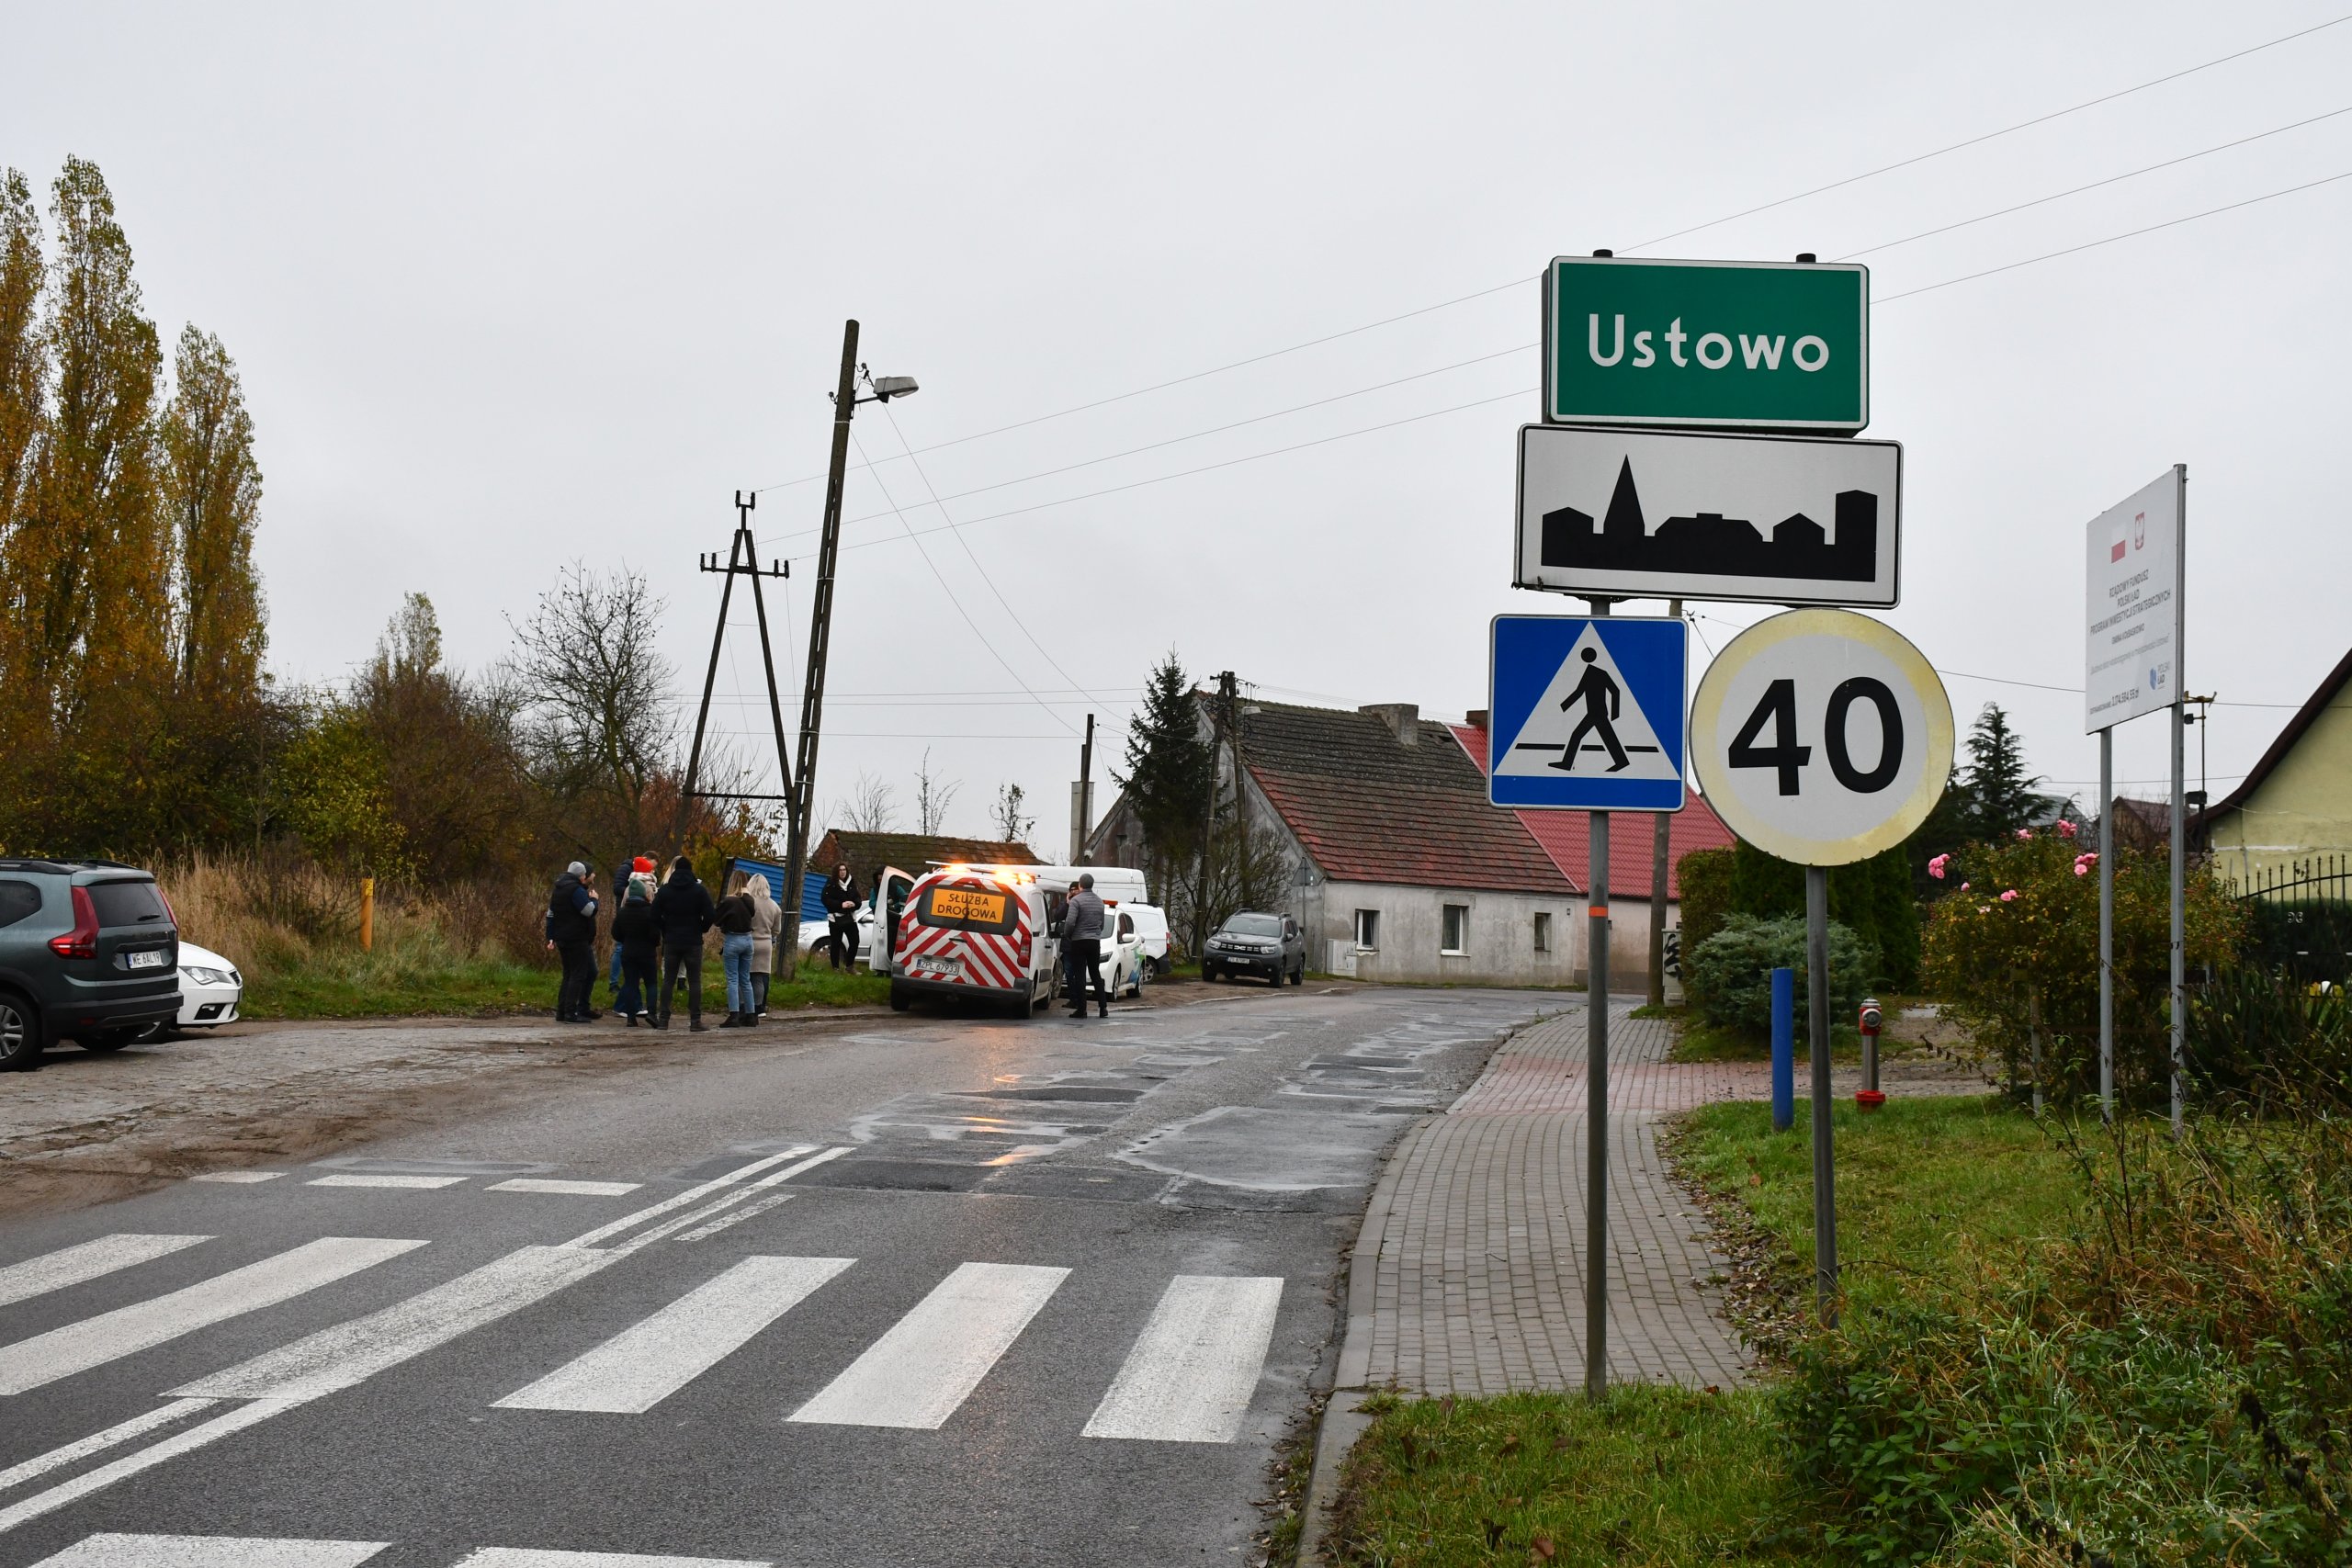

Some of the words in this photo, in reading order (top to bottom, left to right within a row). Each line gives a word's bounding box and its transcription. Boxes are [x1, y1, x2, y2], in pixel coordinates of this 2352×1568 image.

[1588, 312, 1830, 373] Ustowo
[1727, 675, 1905, 796] 40
[948, 893, 989, 907] SŁUŻBA
[937, 904, 997, 920] DROGOWA
[133, 953, 141, 964] WE
[922, 959, 933, 970] ZPL
[936, 964, 958, 974] 67933
